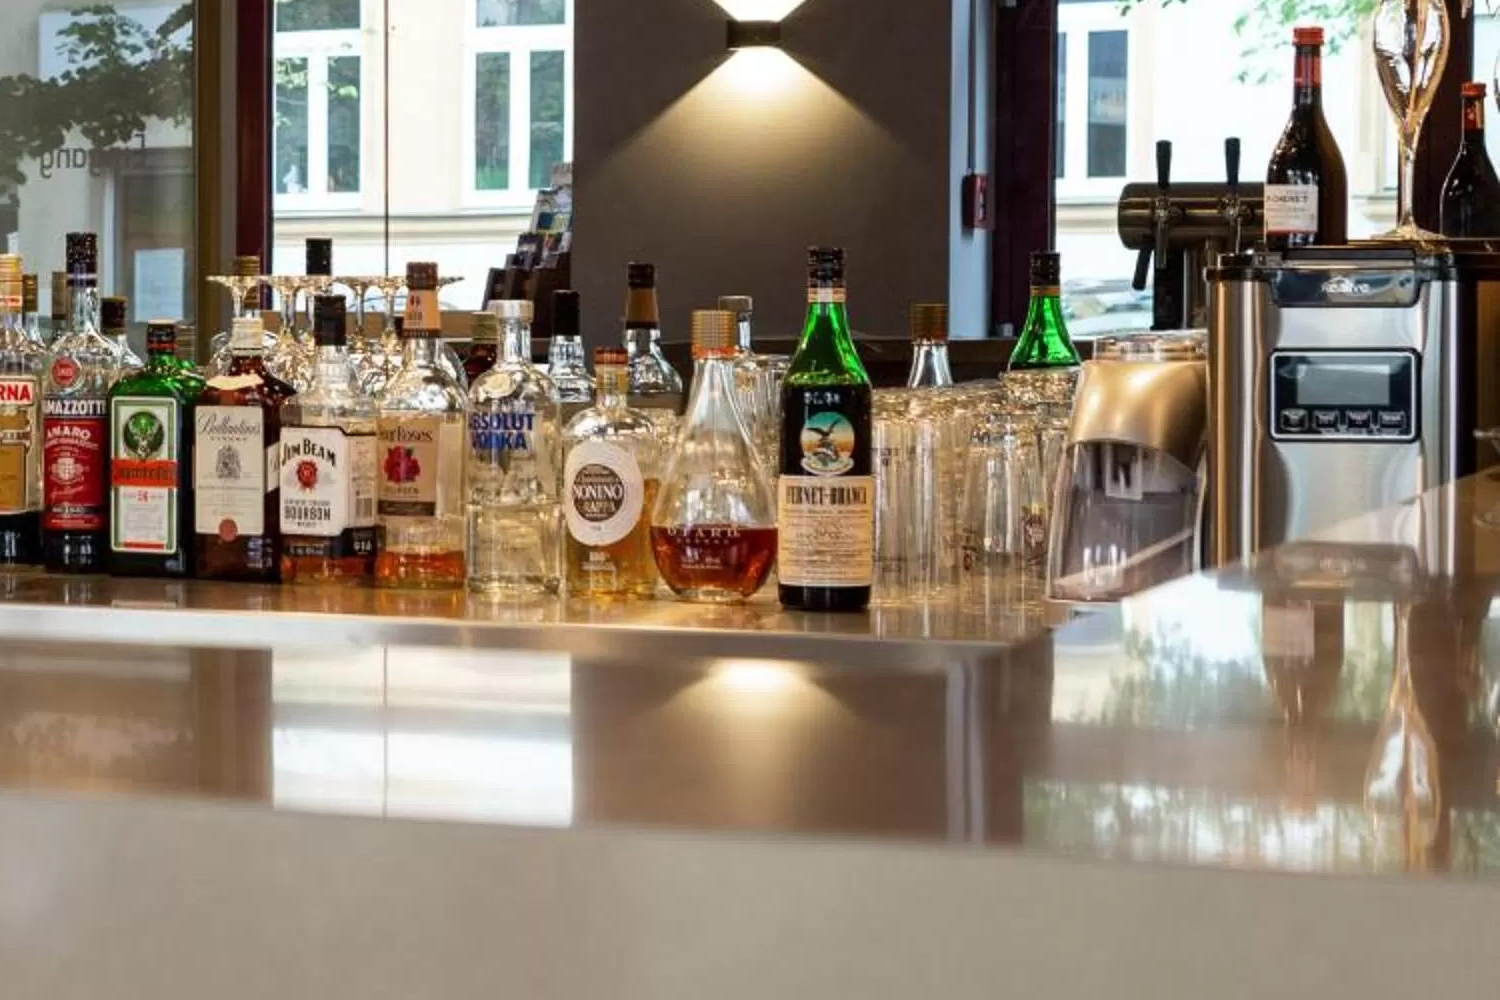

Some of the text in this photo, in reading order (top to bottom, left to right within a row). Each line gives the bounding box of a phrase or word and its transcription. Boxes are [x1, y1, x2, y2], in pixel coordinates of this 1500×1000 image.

[282, 438, 336, 466] JIM BEAM
[572, 483, 623, 499] NONINO
